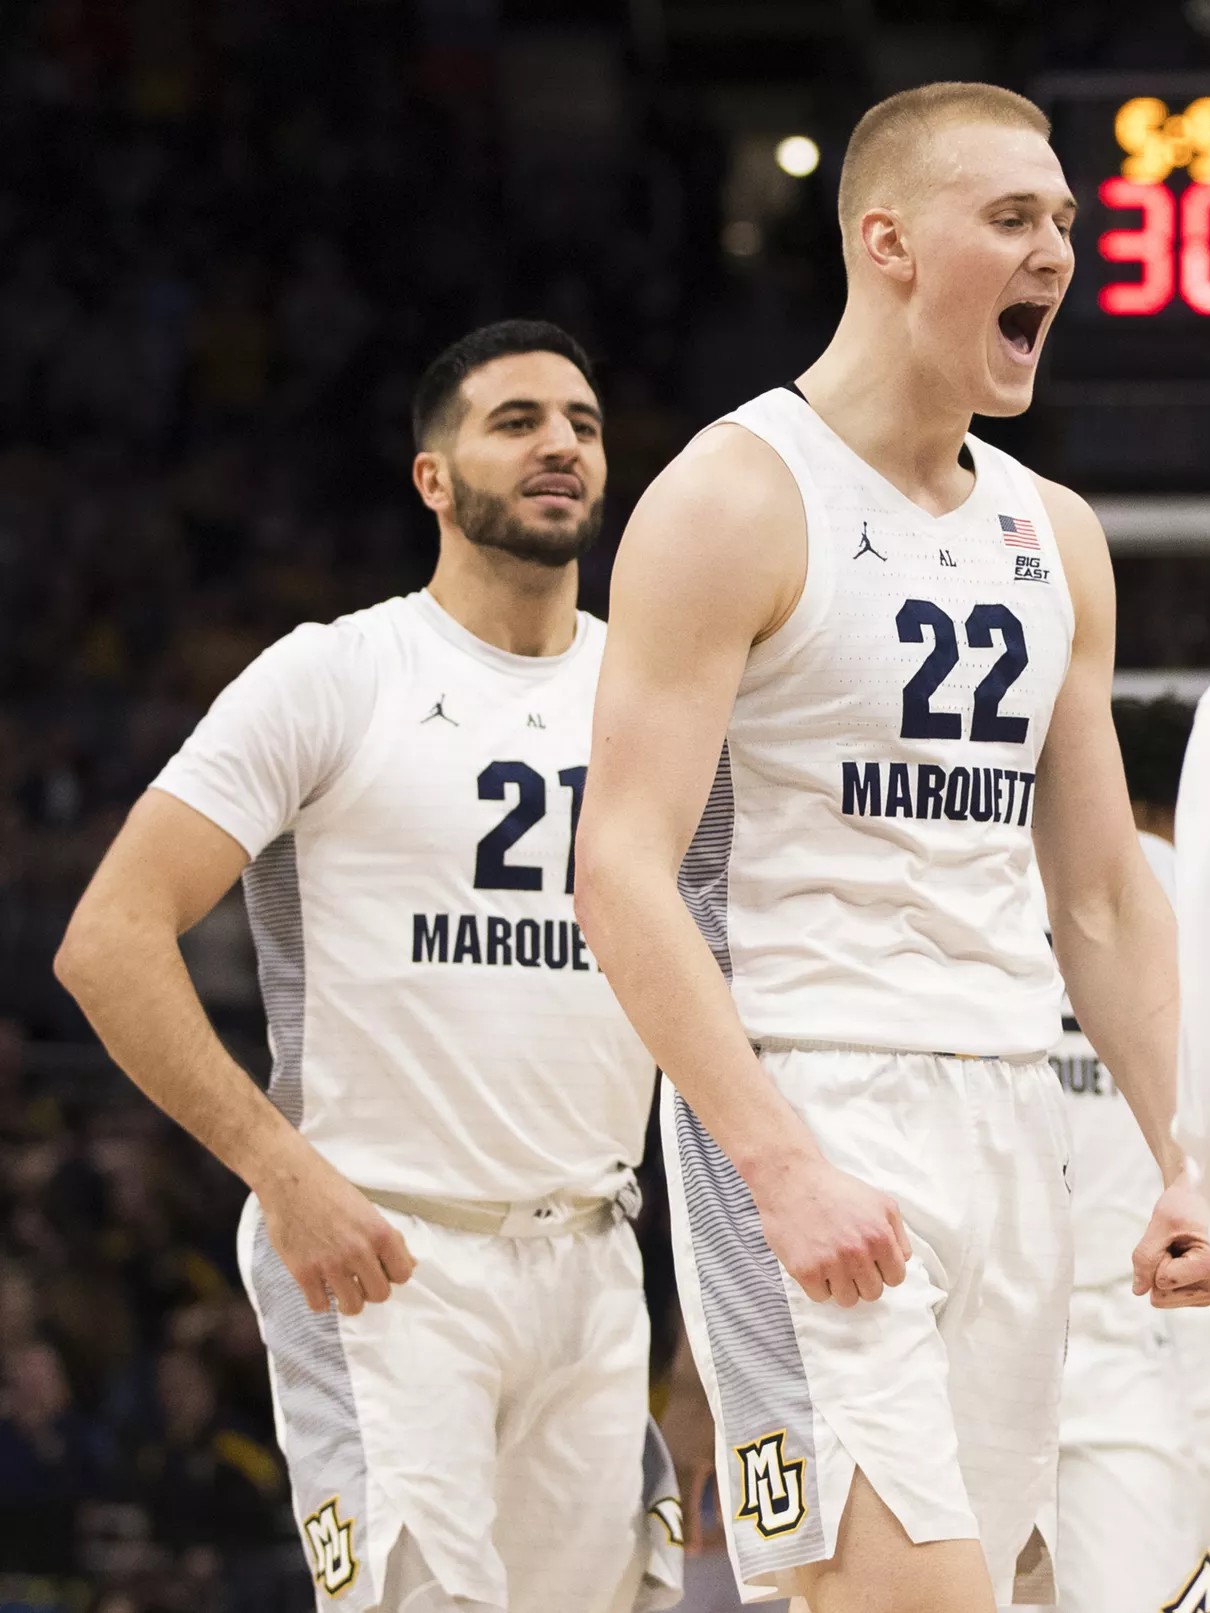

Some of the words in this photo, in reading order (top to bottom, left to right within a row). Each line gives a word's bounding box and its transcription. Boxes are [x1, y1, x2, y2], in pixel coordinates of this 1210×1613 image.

[939, 549, 957, 567] AL
[1014, 567, 1050, 580] EAST
[1015, 555, 1040, 568] BIG
[896, 599, 1029, 744] 22
[412, 914, 603, 974] MARQUE
[733, 1428, 808, 1541] MU
[303, 1493, 360, 1598] MU
